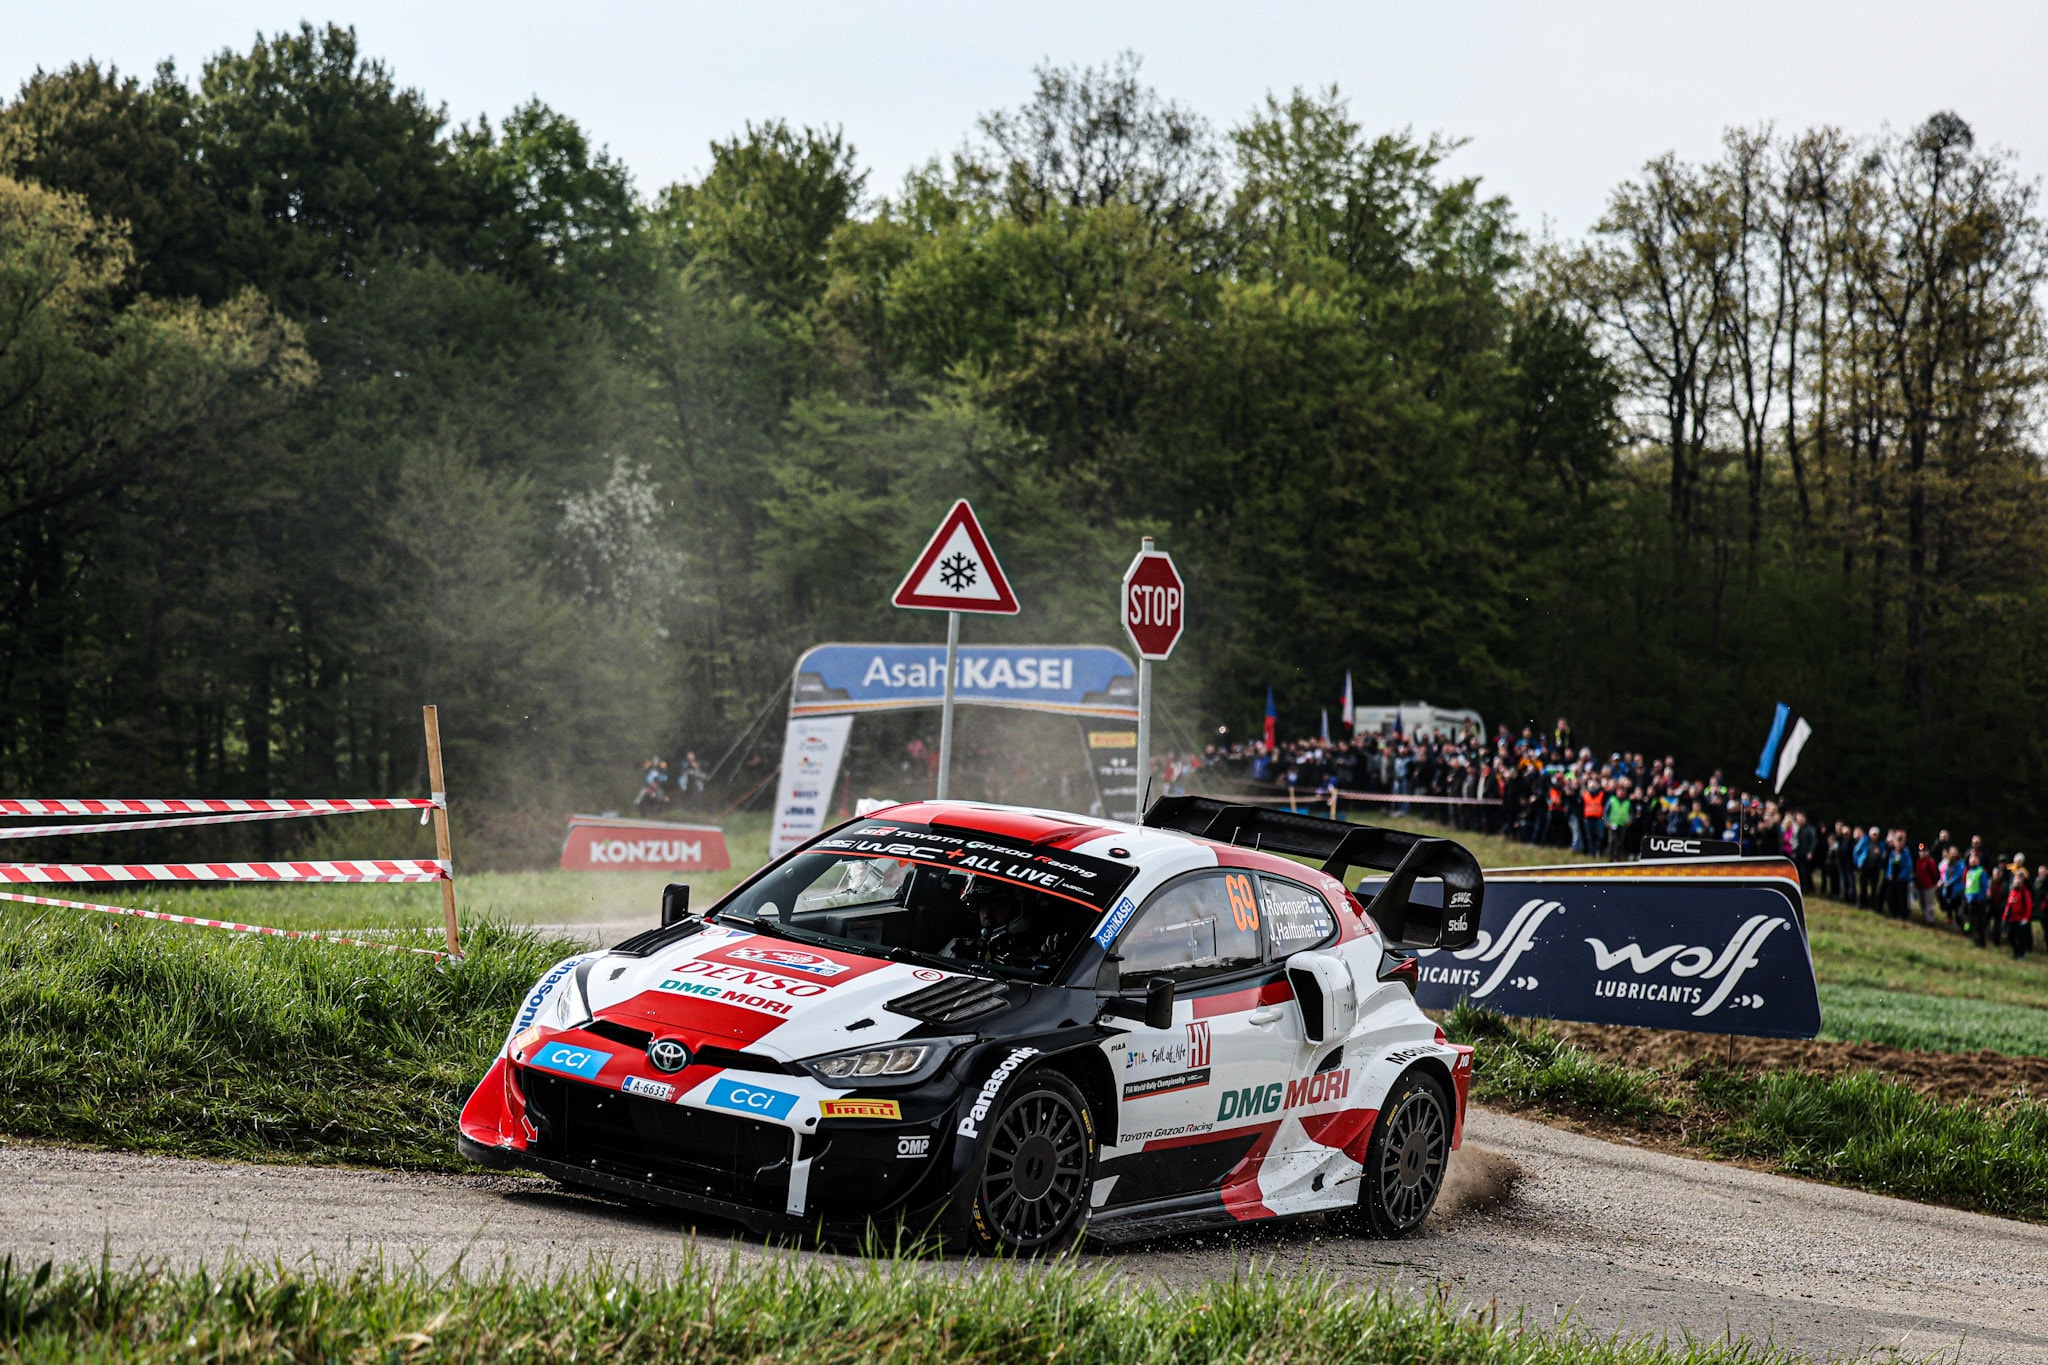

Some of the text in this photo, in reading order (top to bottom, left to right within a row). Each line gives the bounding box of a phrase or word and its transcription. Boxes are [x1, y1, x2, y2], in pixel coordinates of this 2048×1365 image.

[1129, 584, 1179, 627] STOP
[589, 840, 702, 863] KONZUM
[895, 830, 966, 845] TOYOTA
[966, 841, 1033, 859] GAZOO
[1033, 855, 1098, 878] Racing
[1649, 838, 1701, 854] WRC
[958, 855, 1001, 873] ALL
[1006, 864, 1059, 886] LIVE
[1225, 874, 1260, 932] 69
[1448, 912, 1468, 931] Stilo
[1417, 899, 1561, 999] olf
[671, 961, 835, 998] DENSO
[1595, 980, 1702, 1004] LUBRICANTS
[658, 979, 794, 1015] DMG MORI
[1111, 1042, 1126, 1052] PIAA
[1186, 1022, 1209, 1068] HY
[633, 1081, 666, 1097] A-6633
[957, 1046, 1039, 1140] Panasonic
[1133, 1082, 1146, 1092] World
[1146, 1081, 1157, 1091] Rally
[1157, 1076, 1186, 1088] Championship
[1216, 1068, 1351, 1122] DMG MORI
[826, 1102, 895, 1117] PIRELLI
[1120, 1122, 1214, 1143] TOYOTA GAZOO Racing
[897, 1139, 930, 1154] OMP
